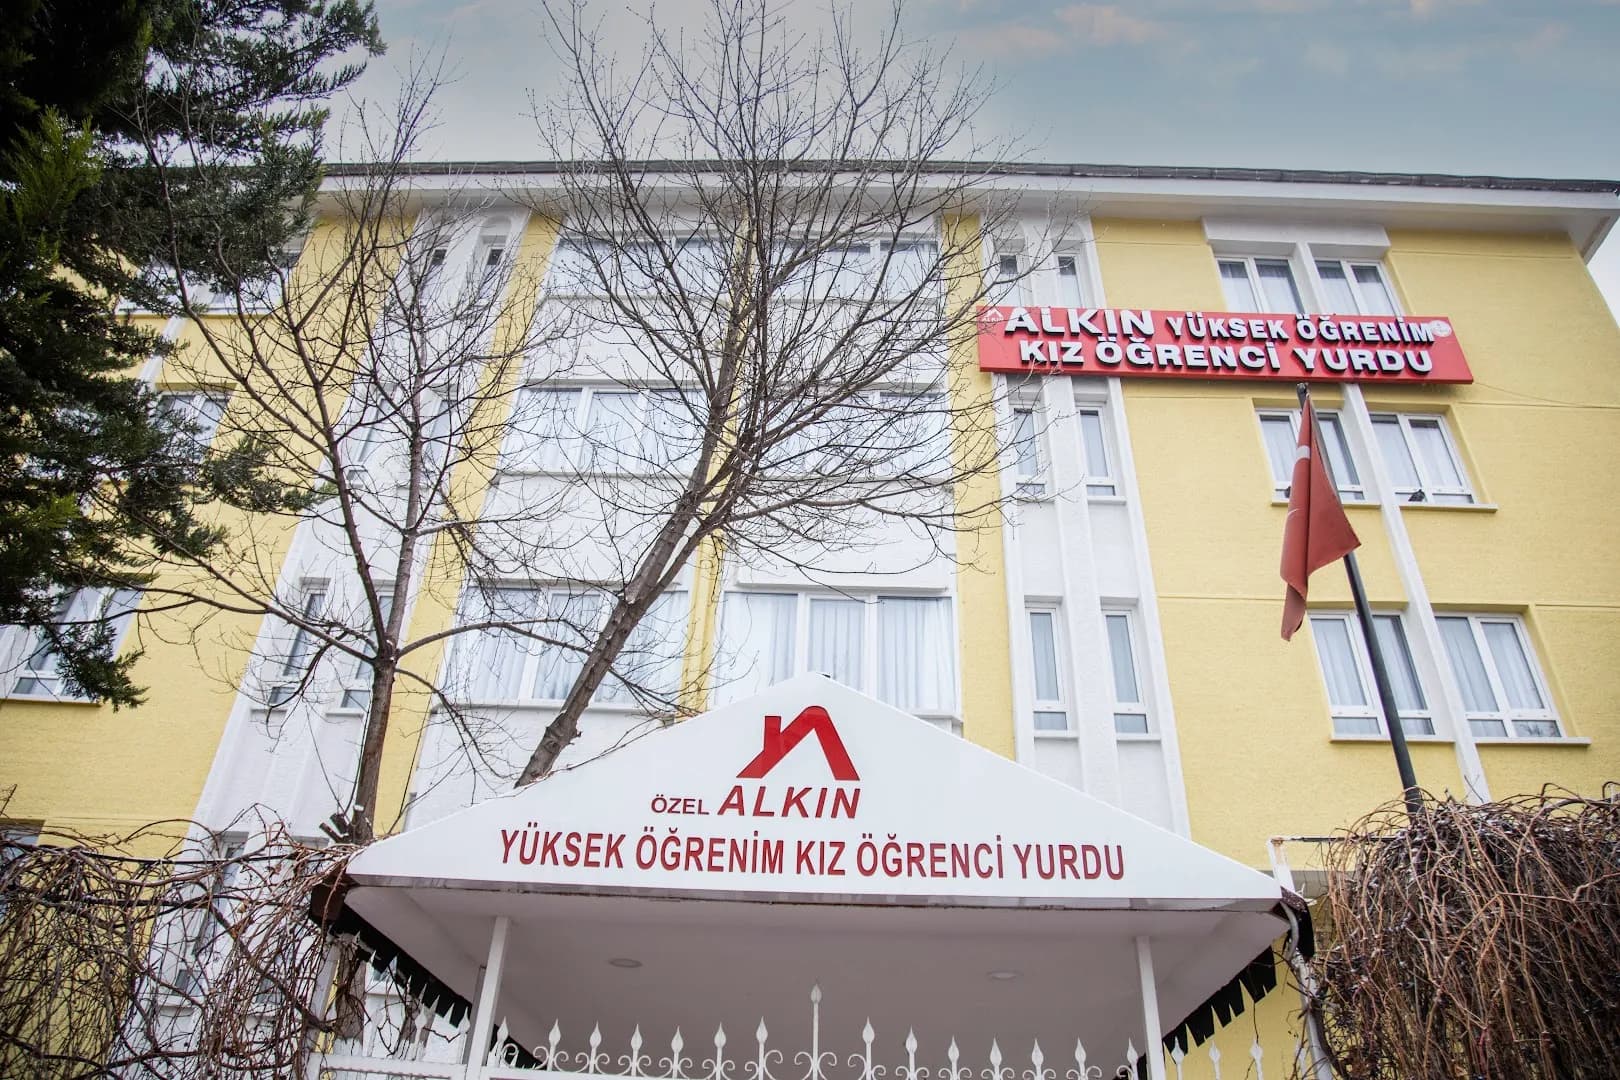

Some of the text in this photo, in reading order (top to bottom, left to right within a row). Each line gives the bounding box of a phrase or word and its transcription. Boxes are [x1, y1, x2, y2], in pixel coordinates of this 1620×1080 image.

[1004, 306, 1154, 336] ALKIN
[1166, 311, 1289, 341] YÜKSEK
[1295, 313, 1434, 344] ÖĞRENİM
[1019, 336, 1433, 373] KIZ ÖĞRENCİ YURDU
[651, 785, 861, 819] ÖZEL ALKIN
[501, 821, 1125, 880] YÜKSEK ÖĞRENİM KIZ ÖĞRENCİ YURDU
